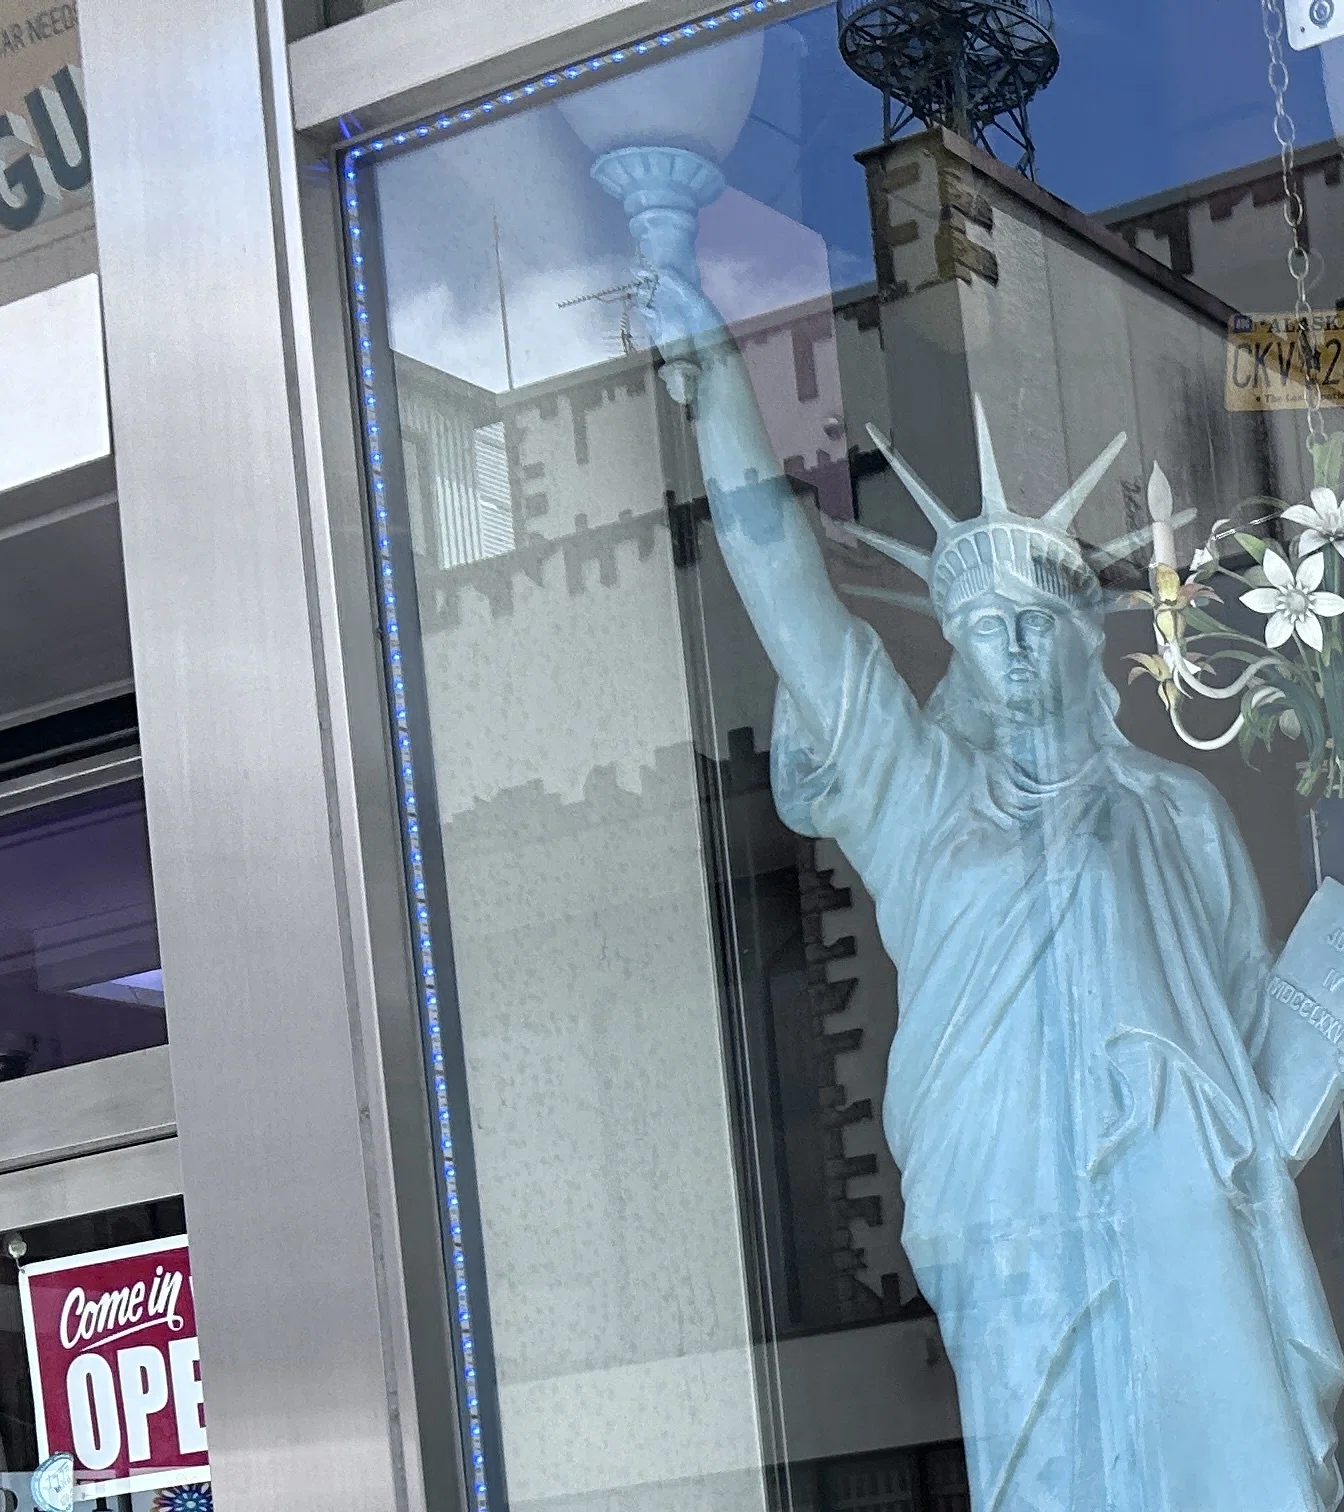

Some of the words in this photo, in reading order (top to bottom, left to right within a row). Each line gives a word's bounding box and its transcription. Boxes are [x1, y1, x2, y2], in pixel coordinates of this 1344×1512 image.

[60, 1278, 145, 1349] Come
[148, 1265, 184, 1331] in
[66, 1335, 209, 1470] OPE
